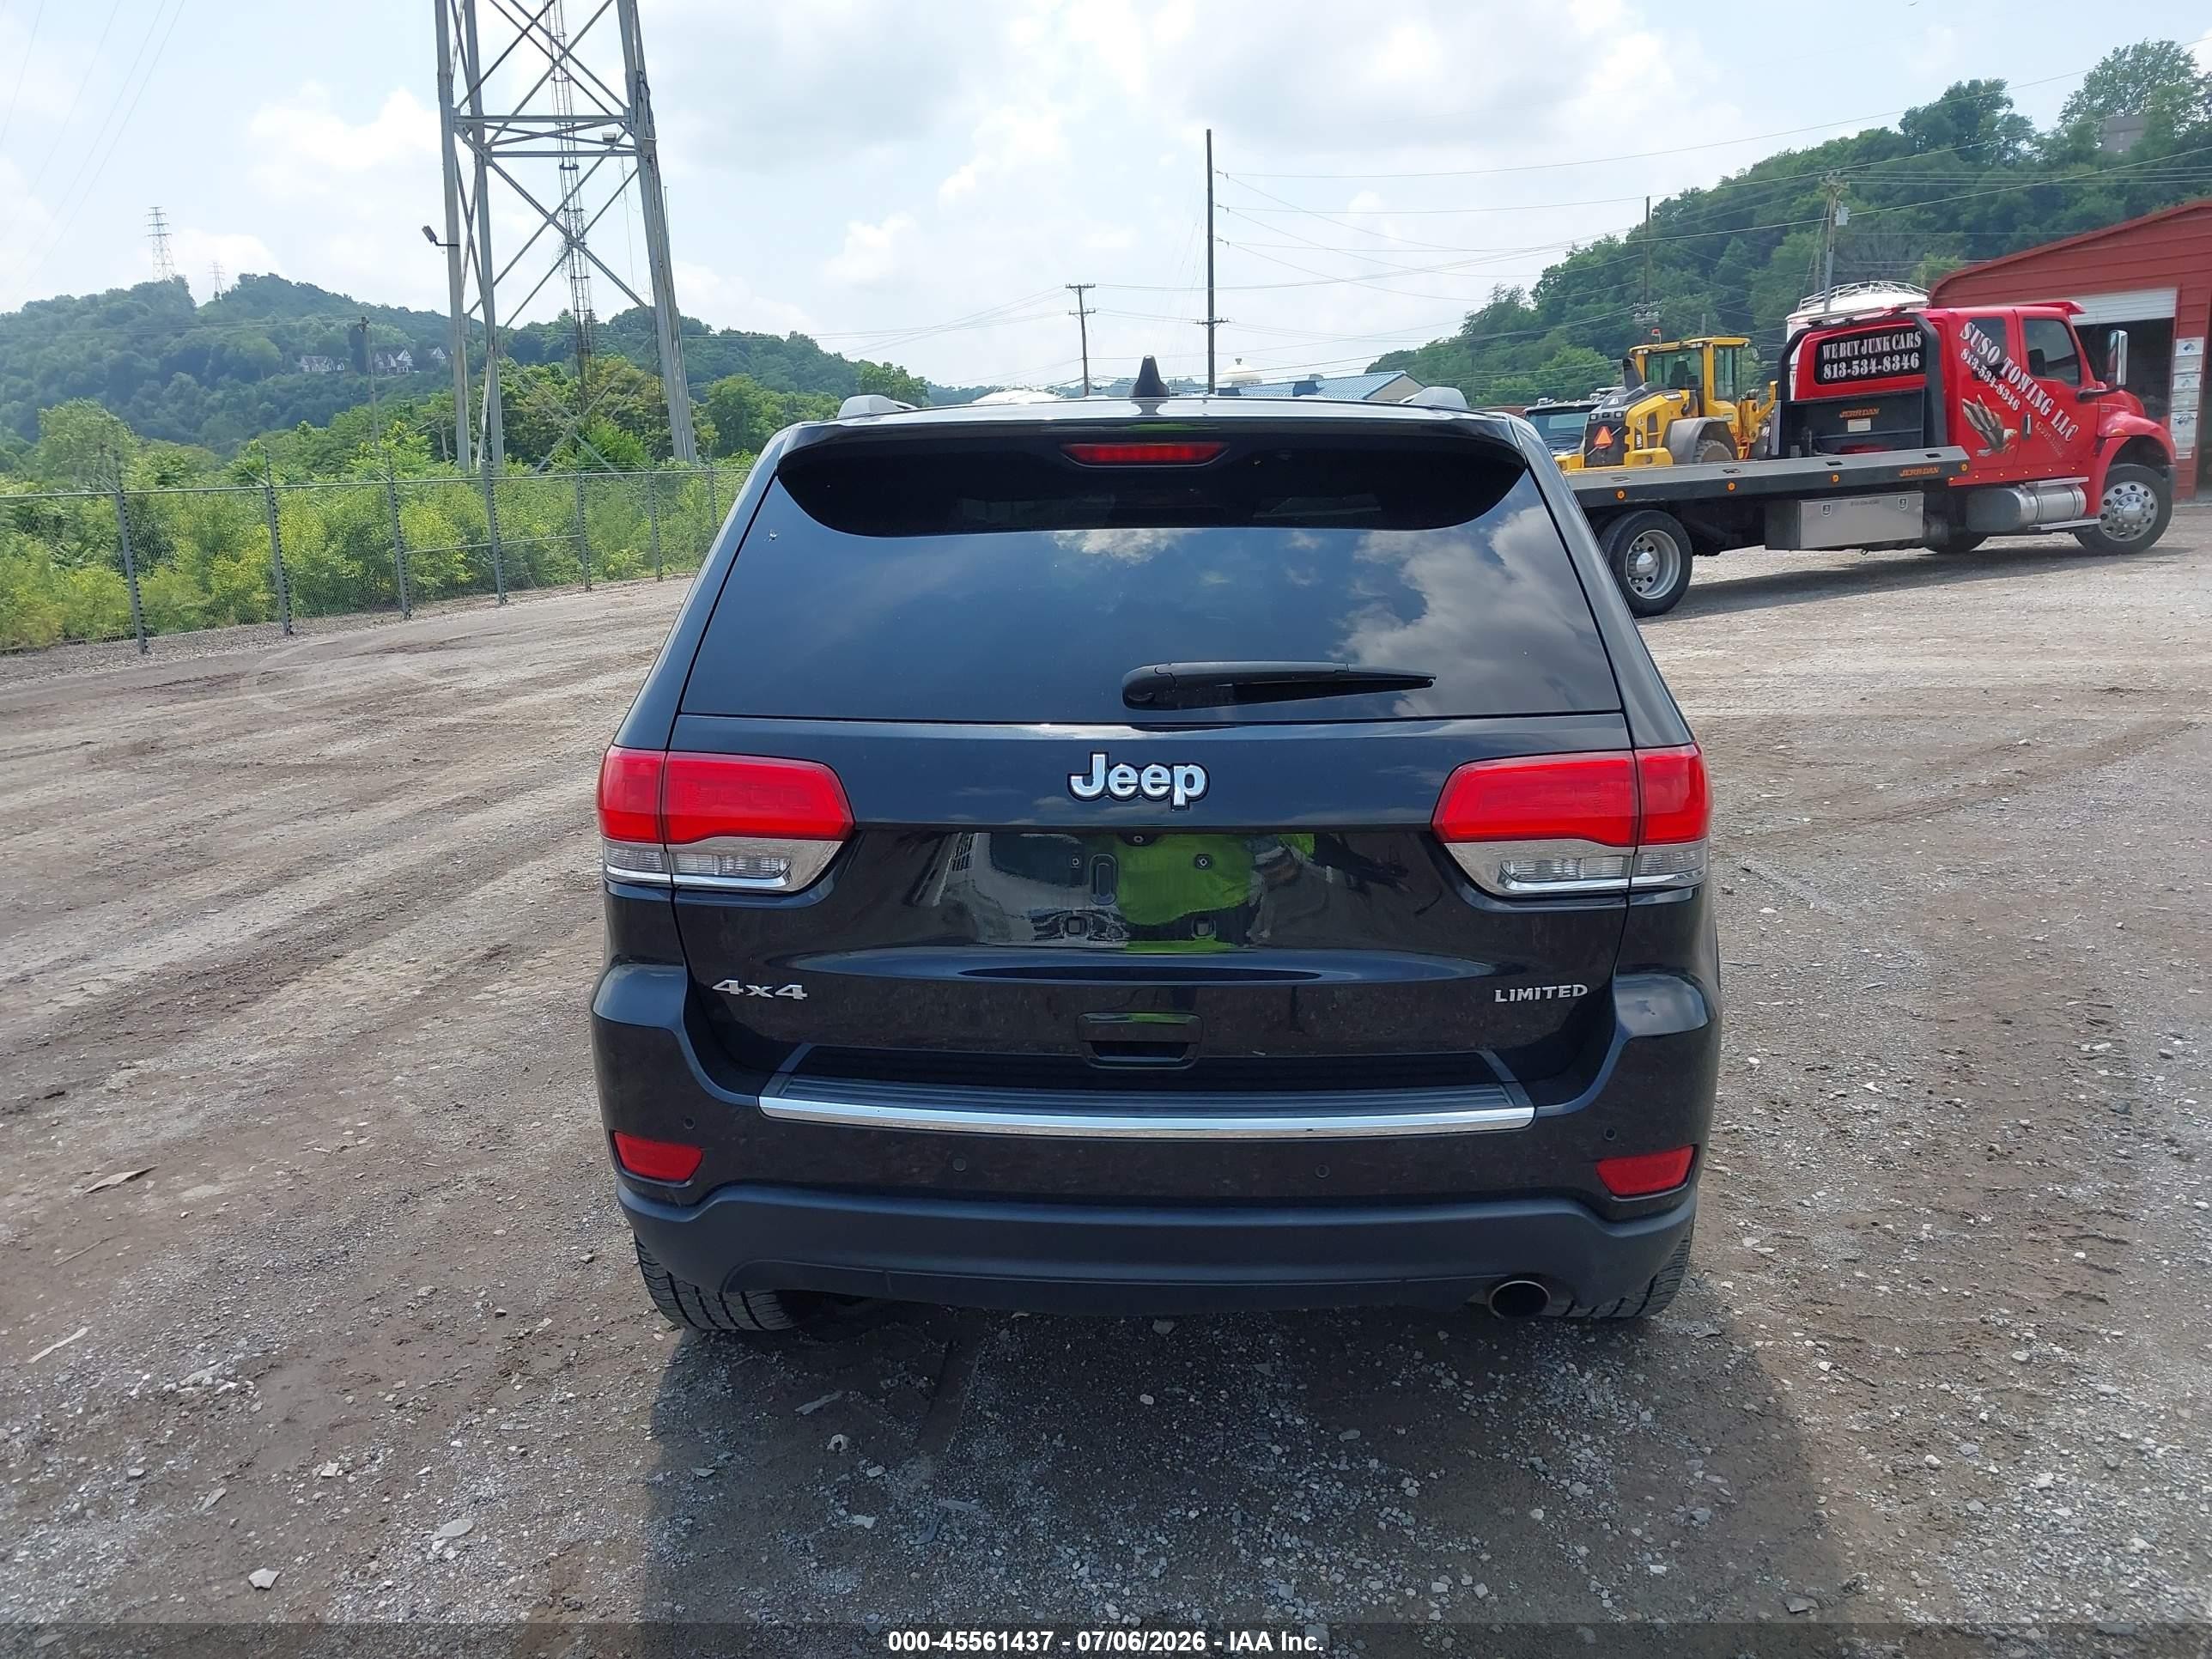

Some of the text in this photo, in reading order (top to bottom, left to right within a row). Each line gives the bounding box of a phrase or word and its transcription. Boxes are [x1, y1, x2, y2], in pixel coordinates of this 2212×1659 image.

[1822, 331, 1923, 361] WE BUY JUNK CARS
[1823, 352, 1921, 380] 813-534-8346
[1960, 348, 2021, 411] 813-534-8346
[1960, 321, 2001, 363] SUSO
[1999, 356, 2055, 417] TOWING
[2050, 409, 2079, 442] LLC
[1069, 752, 1207, 808] Jeep
[712, 979, 808, 1000] 4x4
[1494, 984, 1588, 1002] LIMITED
